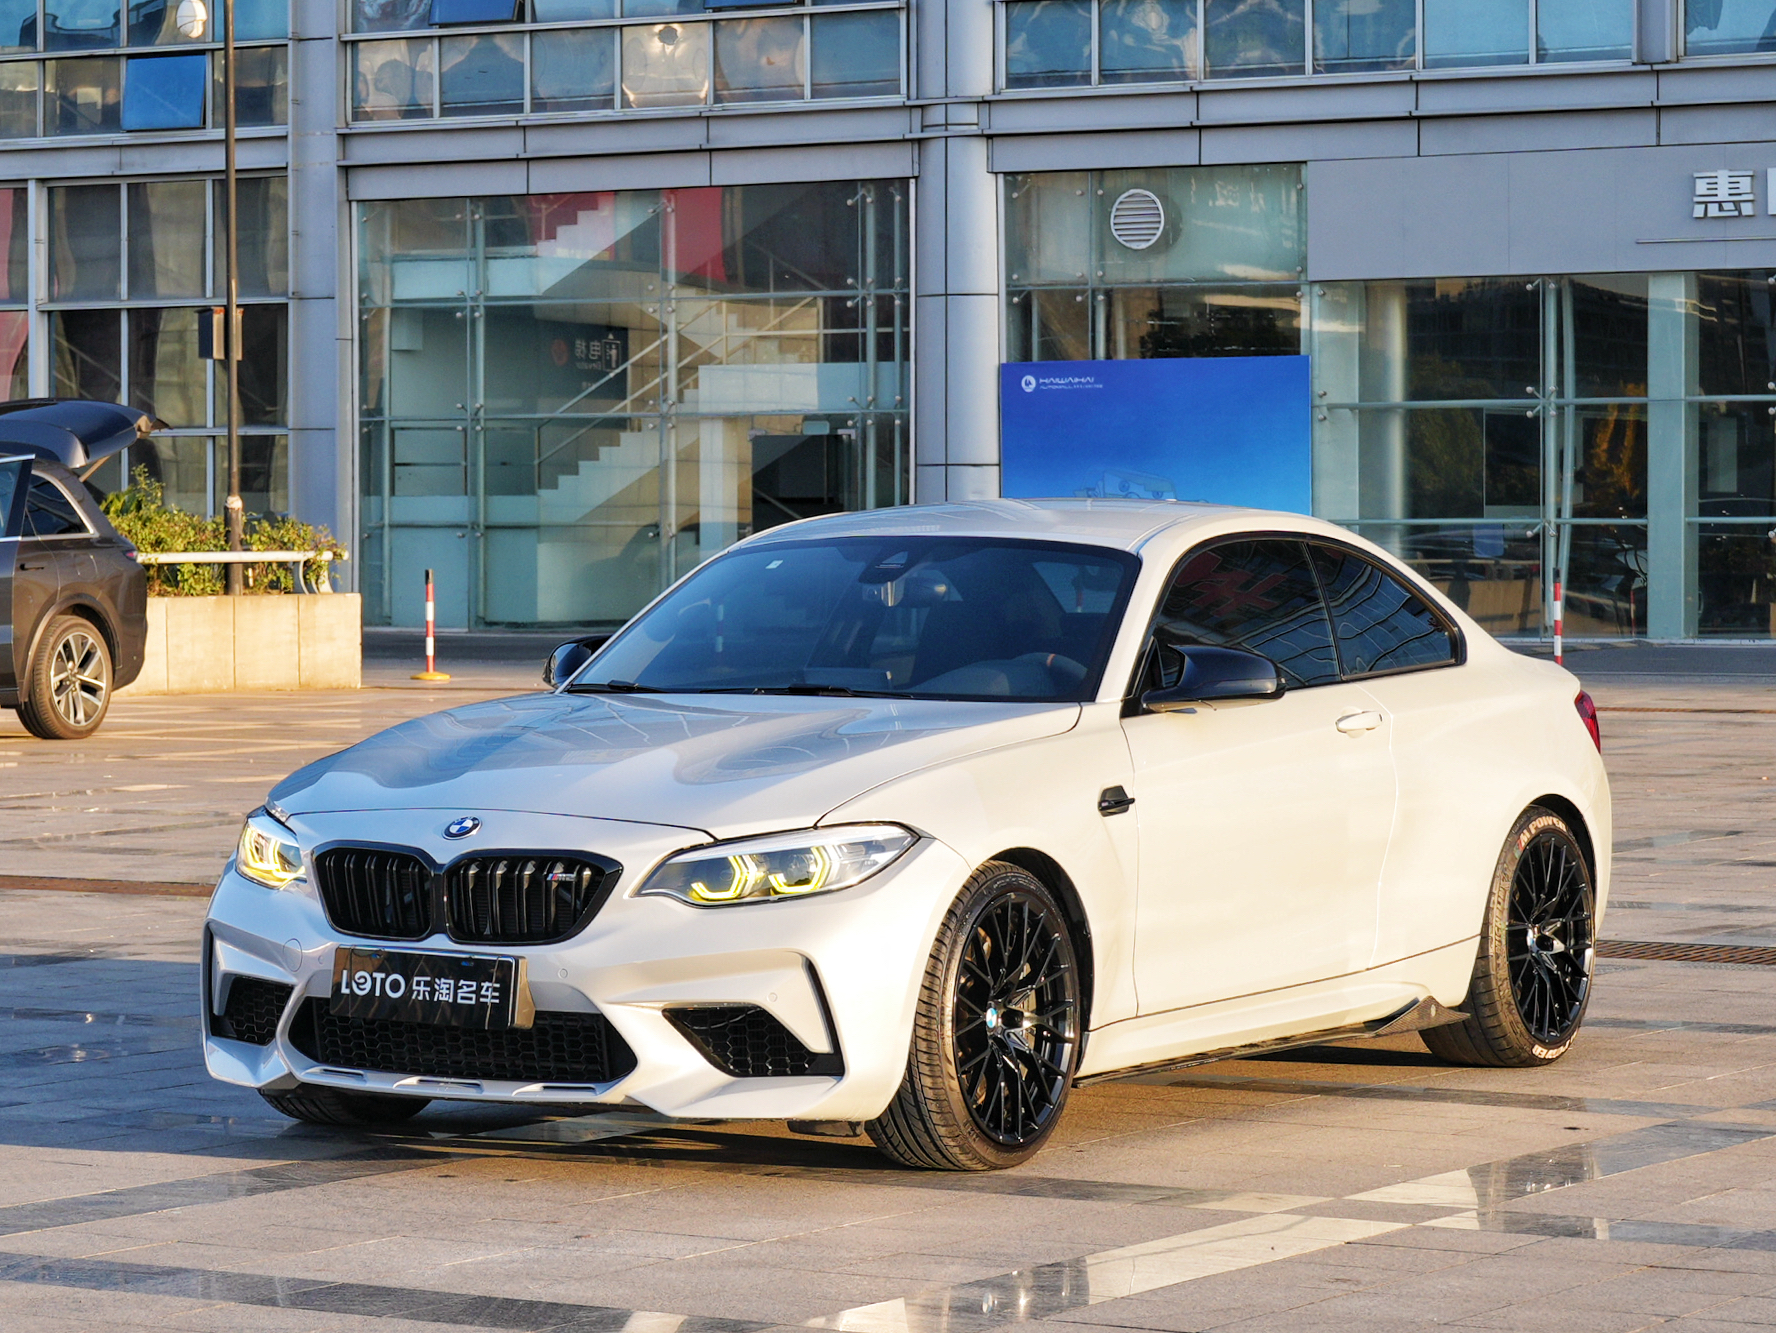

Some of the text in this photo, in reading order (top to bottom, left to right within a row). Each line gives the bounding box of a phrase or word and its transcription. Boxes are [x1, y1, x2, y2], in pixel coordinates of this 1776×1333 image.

[1692, 167, 1776, 218] 惠
[341, 970, 500, 1005] LOTO 乐淘名车
